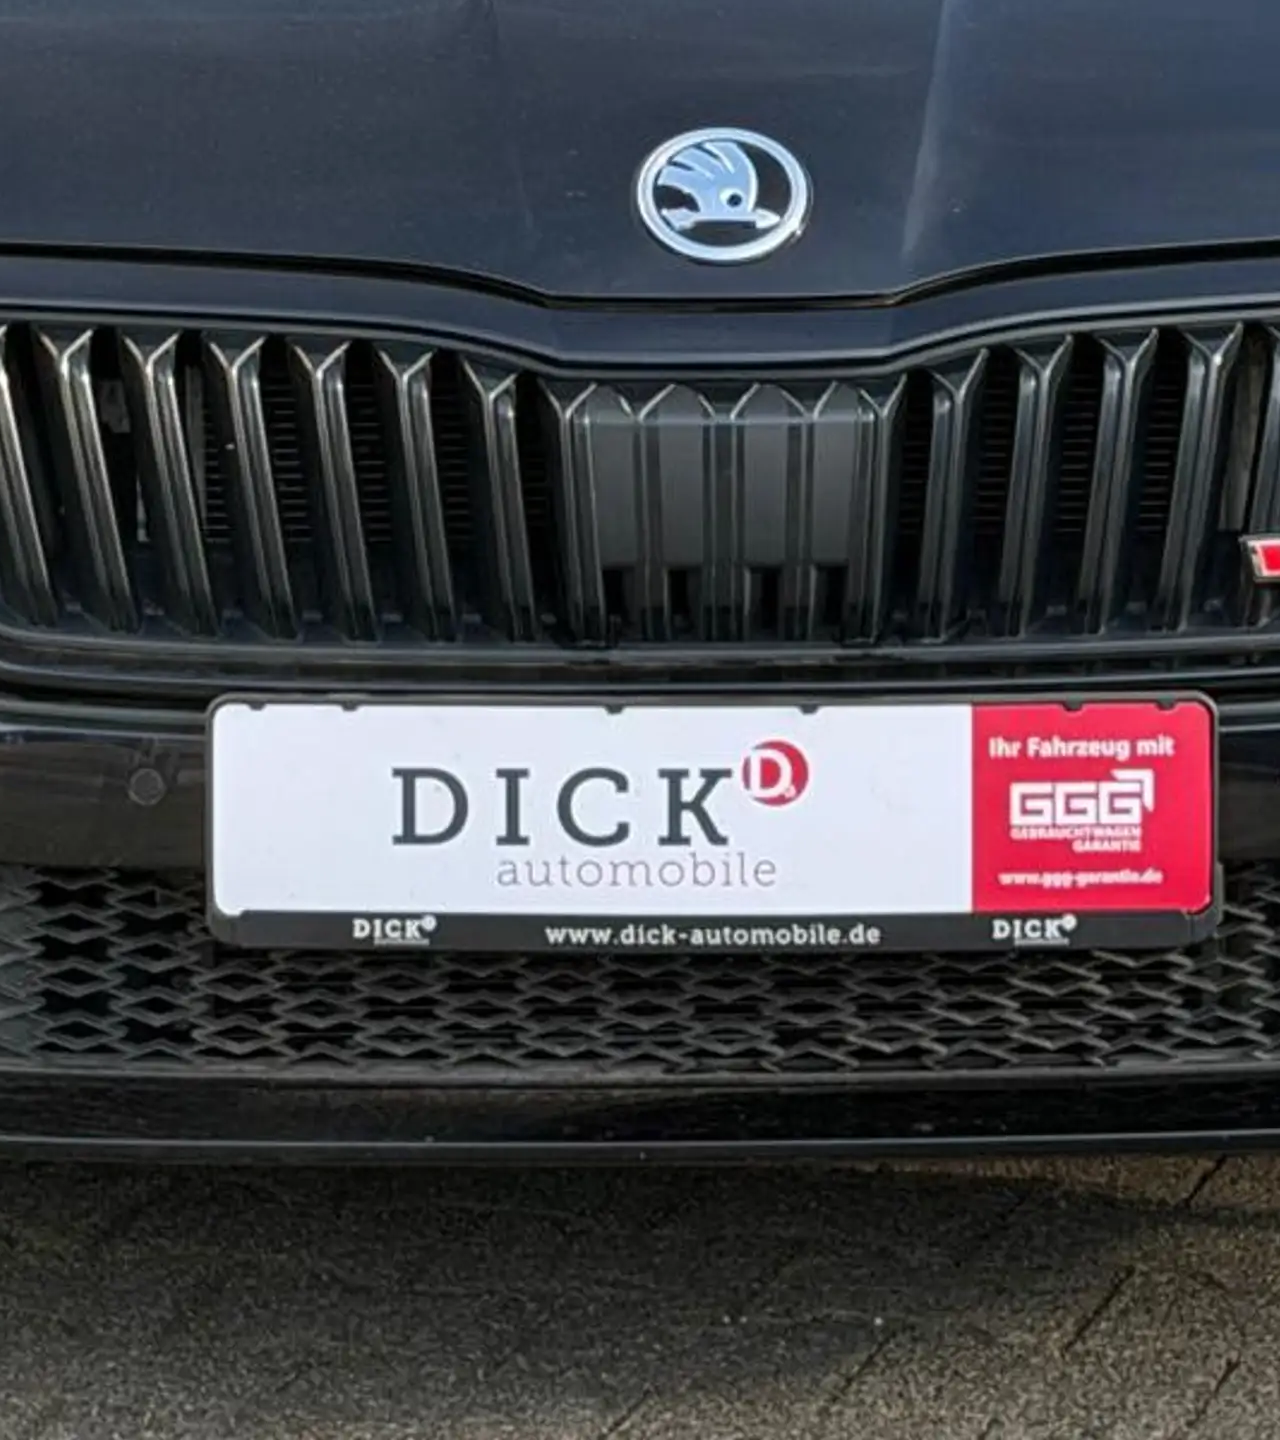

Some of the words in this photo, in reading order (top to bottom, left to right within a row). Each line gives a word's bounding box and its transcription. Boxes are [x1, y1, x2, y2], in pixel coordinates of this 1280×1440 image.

[988, 737, 1021, 758] Ihr
[1026, 736, 1131, 761] Fahrzeug
[1136, 735, 1175, 757] mit
[392, 766, 733, 847] DICK
[1009, 781, 1142, 825] GGG
[495, 852, 778, 888] automobile
[352, 918, 422, 939] DICK
[545, 923, 881, 946] www.dick-automobile.de
[992, 918, 1062, 939] DICK
